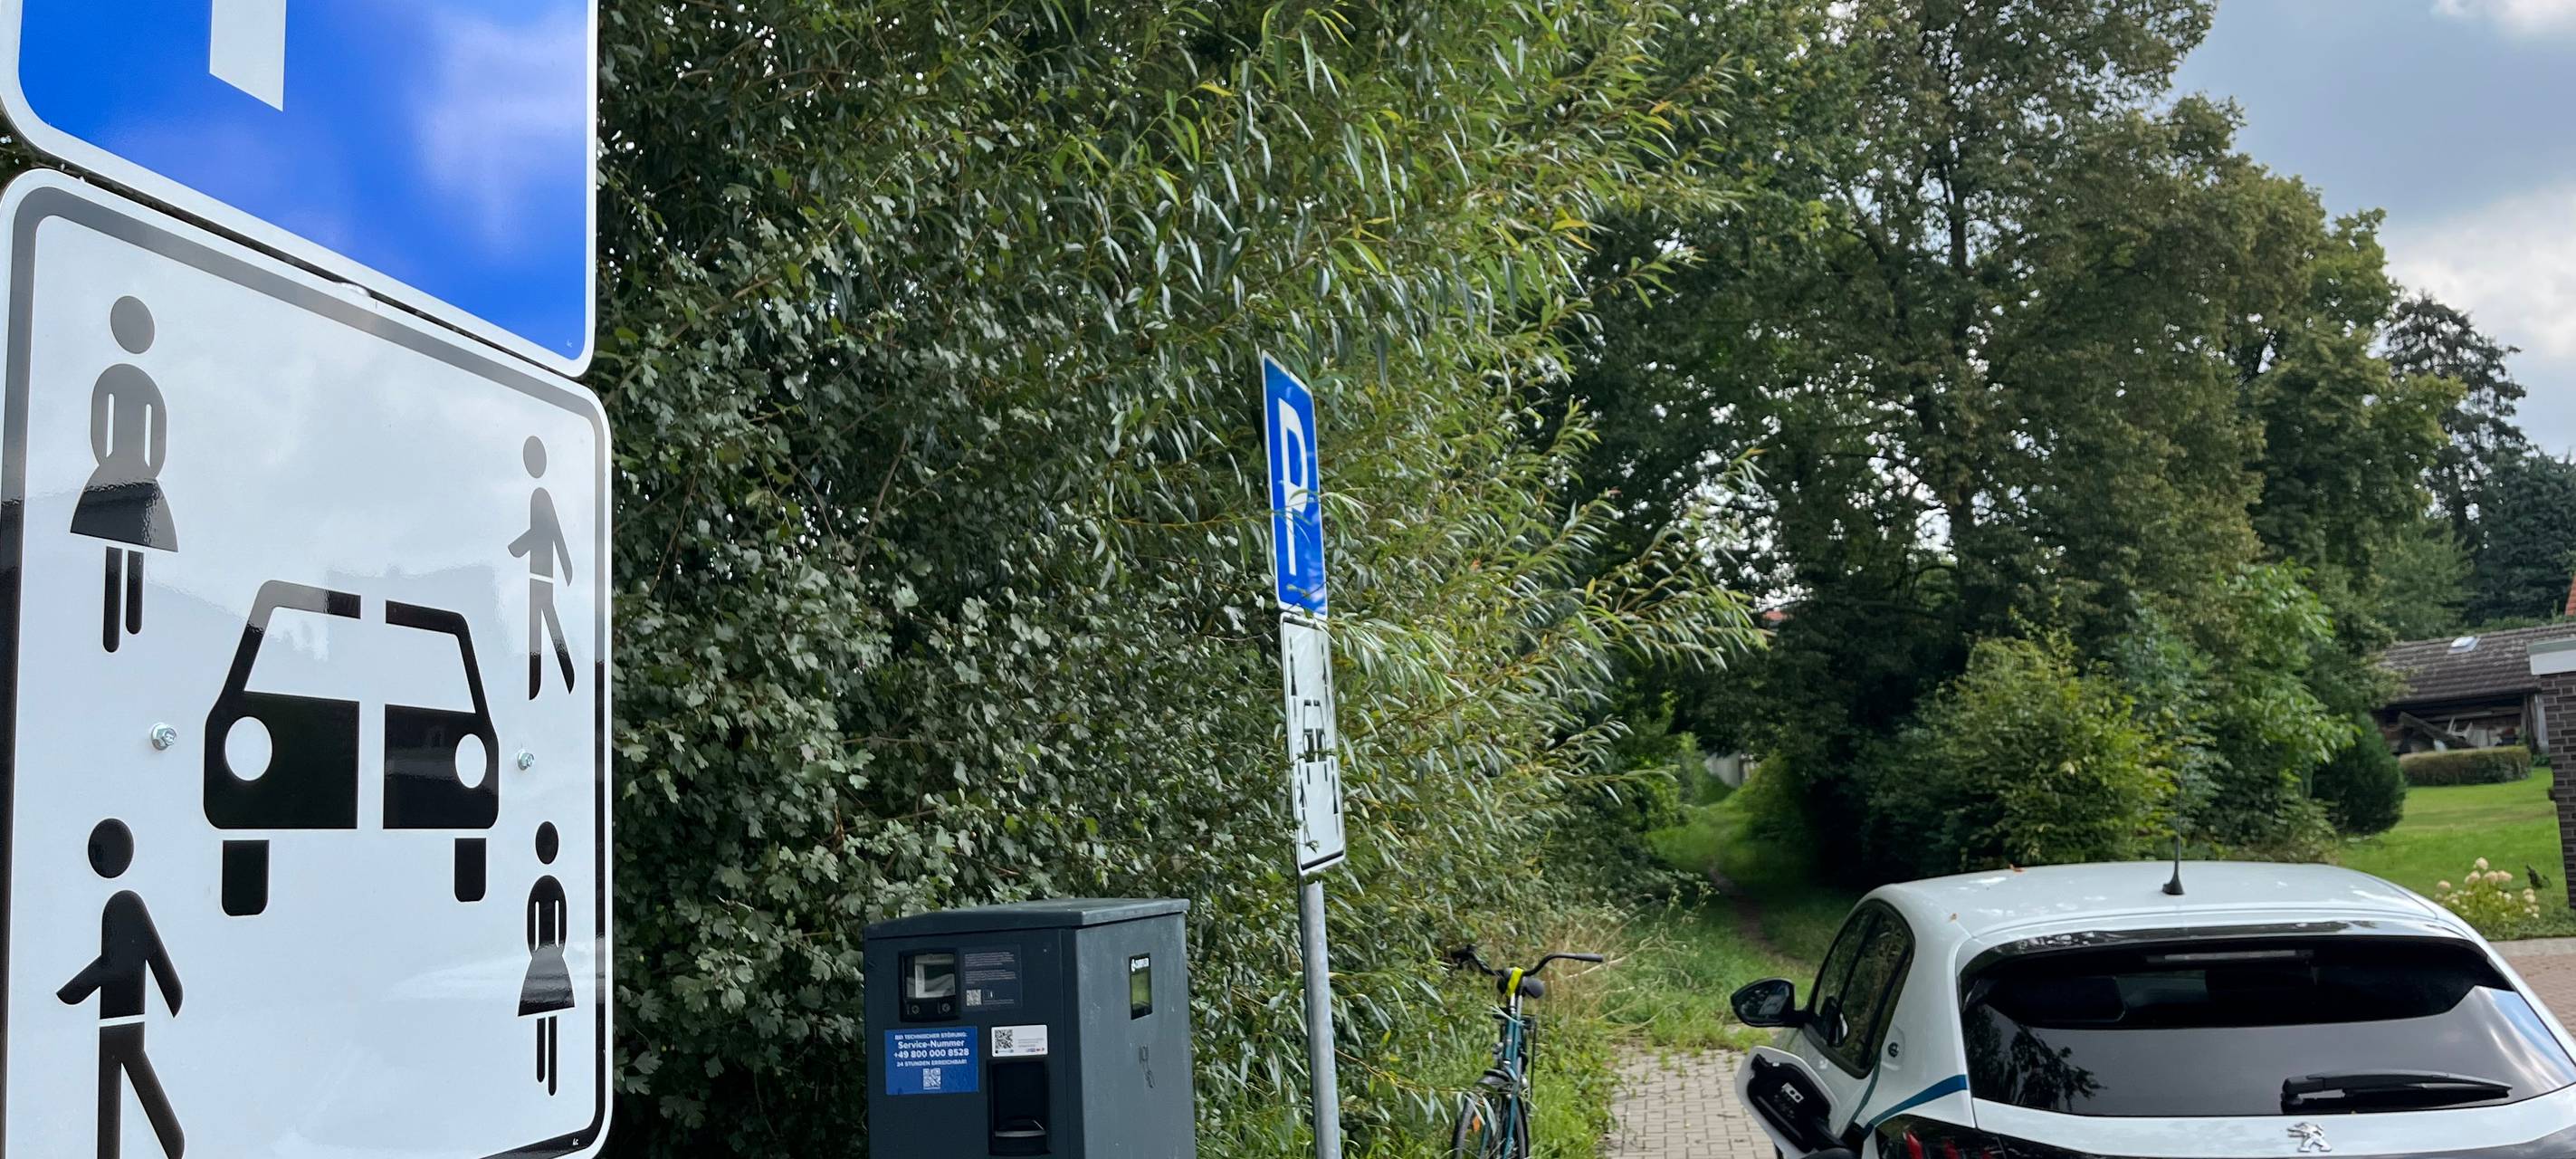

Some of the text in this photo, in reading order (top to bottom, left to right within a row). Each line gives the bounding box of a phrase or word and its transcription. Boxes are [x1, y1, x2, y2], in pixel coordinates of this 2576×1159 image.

[1278, 398, 1308, 576] P
[898, 1039, 965, 1049] Service-Nummer
[893, 1048, 969, 1058] +49 800 000 8528
